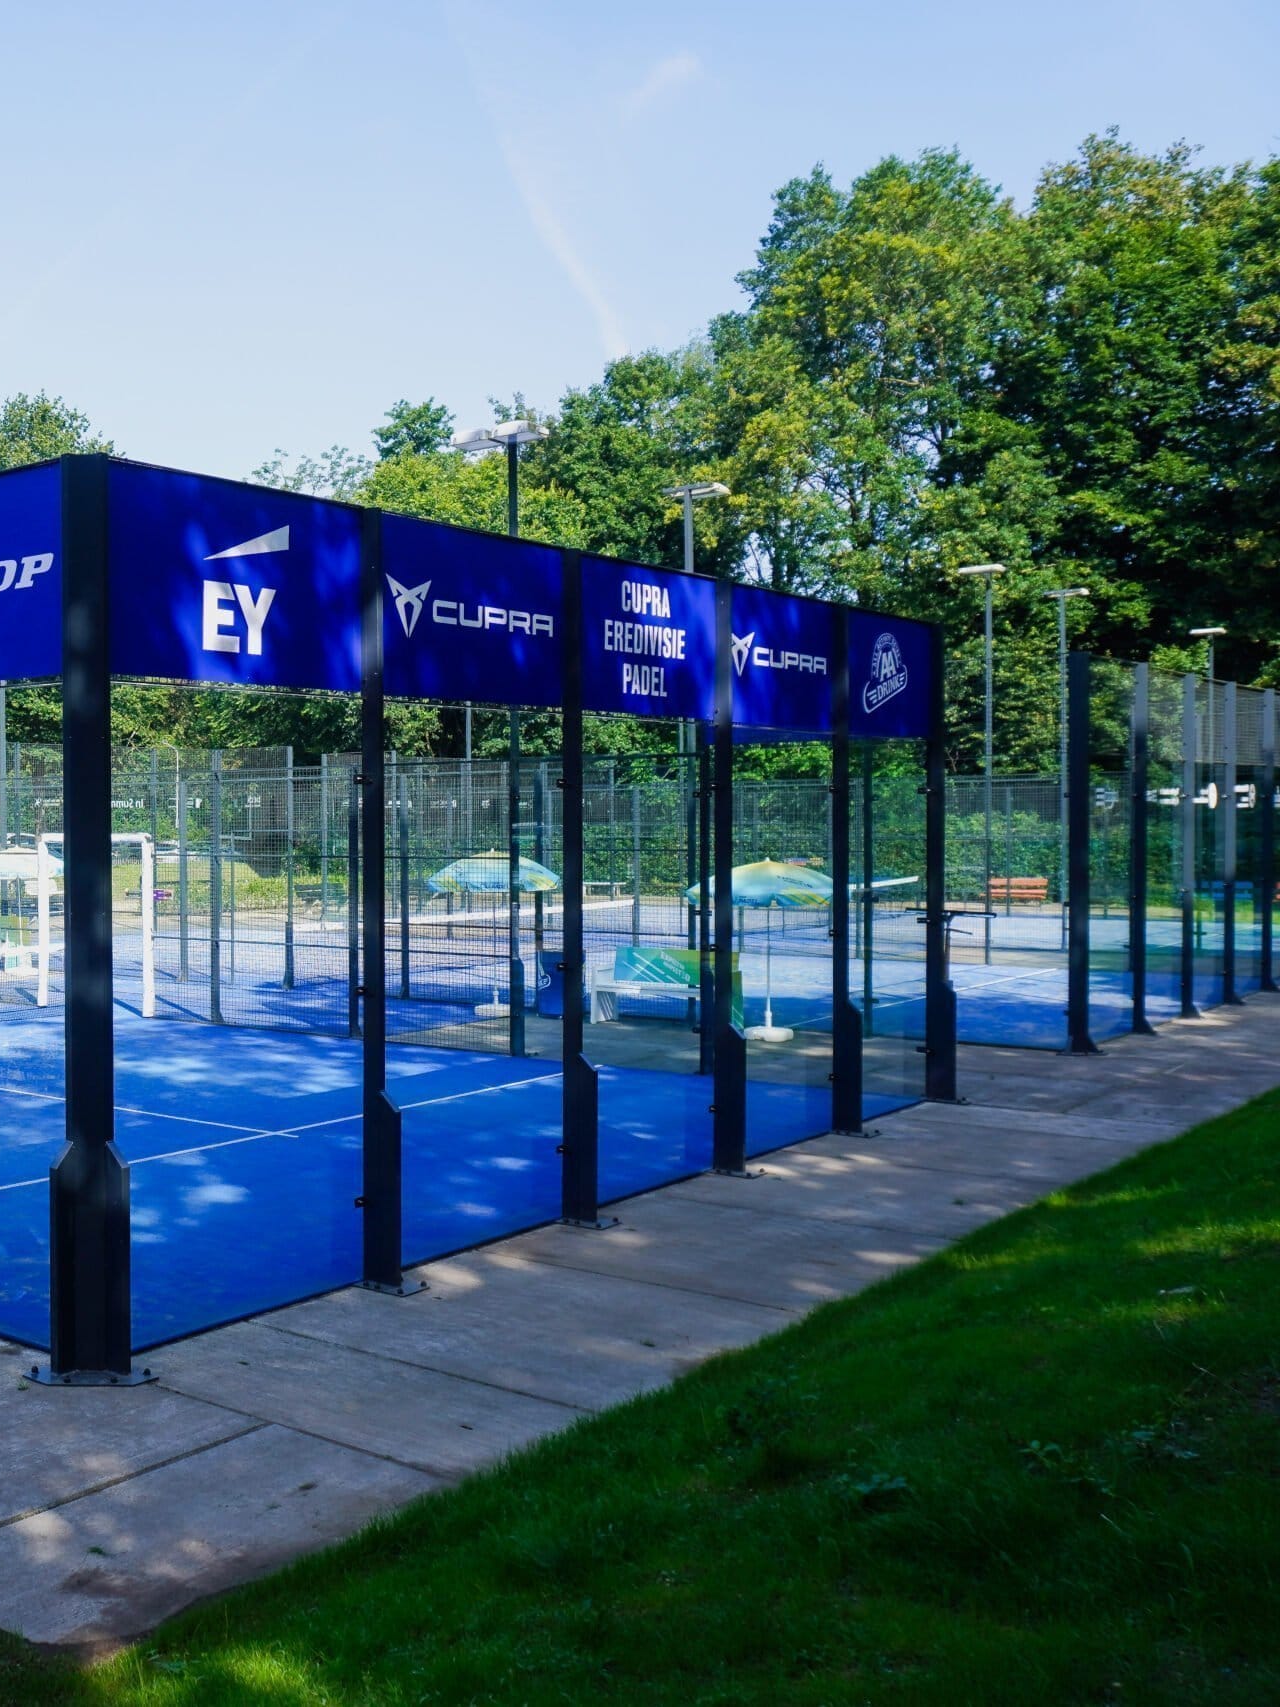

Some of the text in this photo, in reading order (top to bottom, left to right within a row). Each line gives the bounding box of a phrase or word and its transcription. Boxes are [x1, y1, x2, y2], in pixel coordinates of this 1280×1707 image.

[621, 580, 671, 618] CUPRA
[202, 579, 276, 656] EY
[432, 599, 554, 638] CUPRA
[604, 619, 686, 660] EREDIVISIE
[753, 646, 827, 675] CUPRA
[880, 651, 897, 682] AA
[622, 663, 668, 697] PADEL
[876, 674, 901, 701] DRINK
